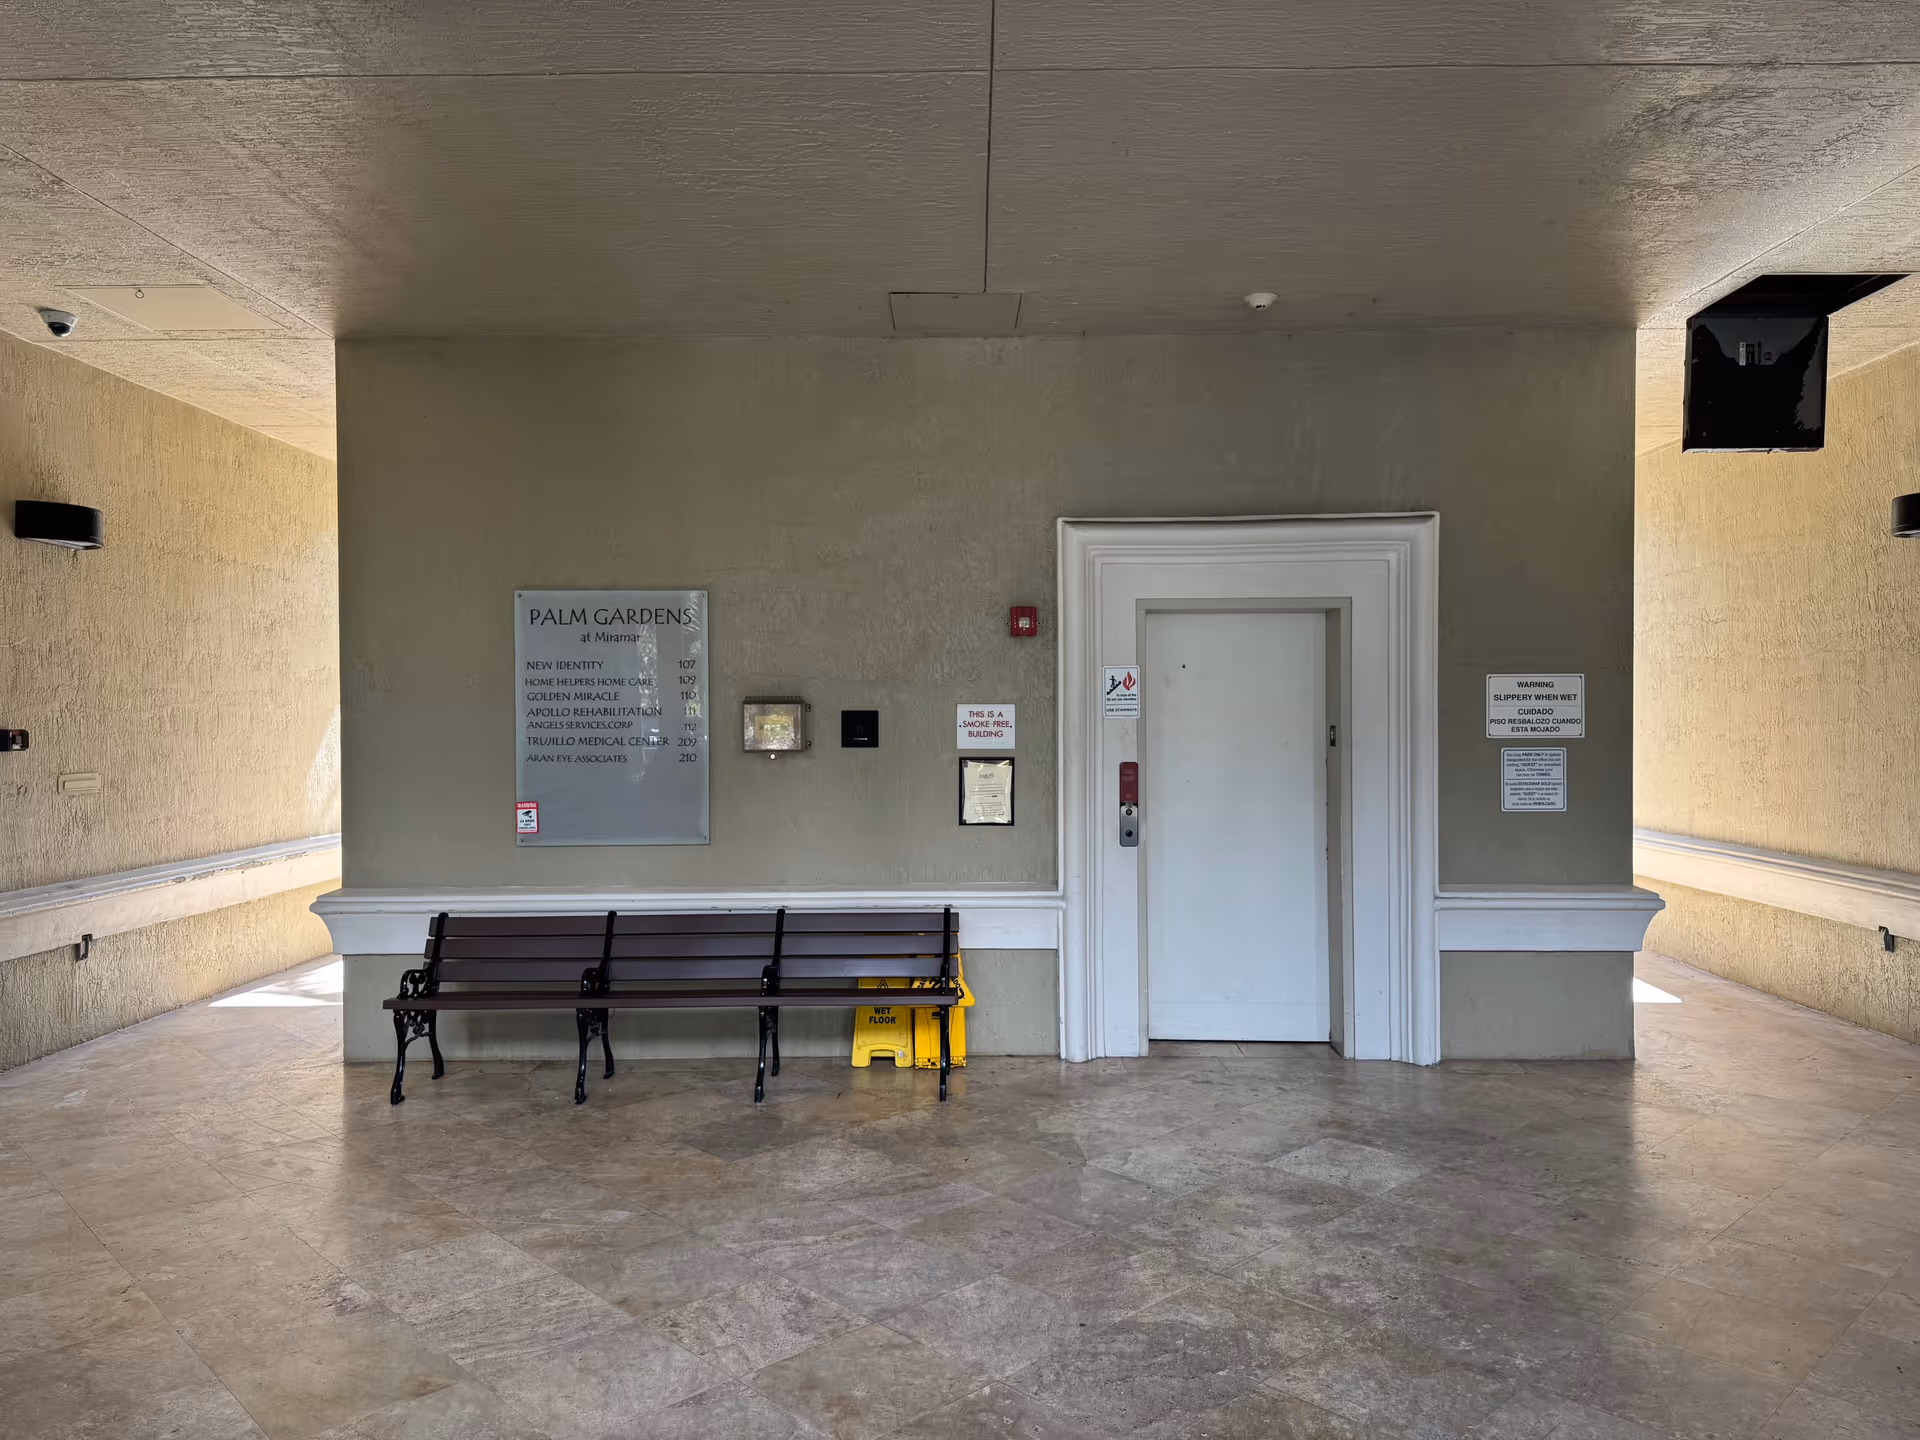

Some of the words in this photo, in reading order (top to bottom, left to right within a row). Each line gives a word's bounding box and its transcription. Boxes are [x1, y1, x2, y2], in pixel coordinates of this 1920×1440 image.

[530, 608, 587, 625] PALM
[594, 608, 692, 625] GARDENS
[580, 633, 591, 642] at
[594, 632, 641, 643] Miramar
[527, 661, 552, 670] NEW
[557, 661, 604, 670] IDENTITY
[678, 660, 696, 668] 107
[525, 678, 554, 686] HOME
[557, 678, 595, 686] HELPERS
[598, 678, 626, 686] HOME
[628, 678, 653, 686] CARE
[679, 676, 696, 684] 109
[527, 692, 570, 701] GOLDEN
[574, 692, 620, 700] MIRACLE
[681, 691, 696, 700] 110
[527, 708, 570, 717] APOLLO
[573, 707, 662, 716] REHABILITATION
[684, 706, 696, 716] 111
[527, 721, 564, 729] ANGELS
[684, 722, 696, 731] 112
[527, 737, 575, 746] TRUJILLO
[578, 736, 626, 746] MEDICAL
[628, 736, 670, 746] CENTER
[677, 738, 697, 747] 209
[574, 754, 627, 763] ASSOCIATES
[678, 753, 697, 762] 210
